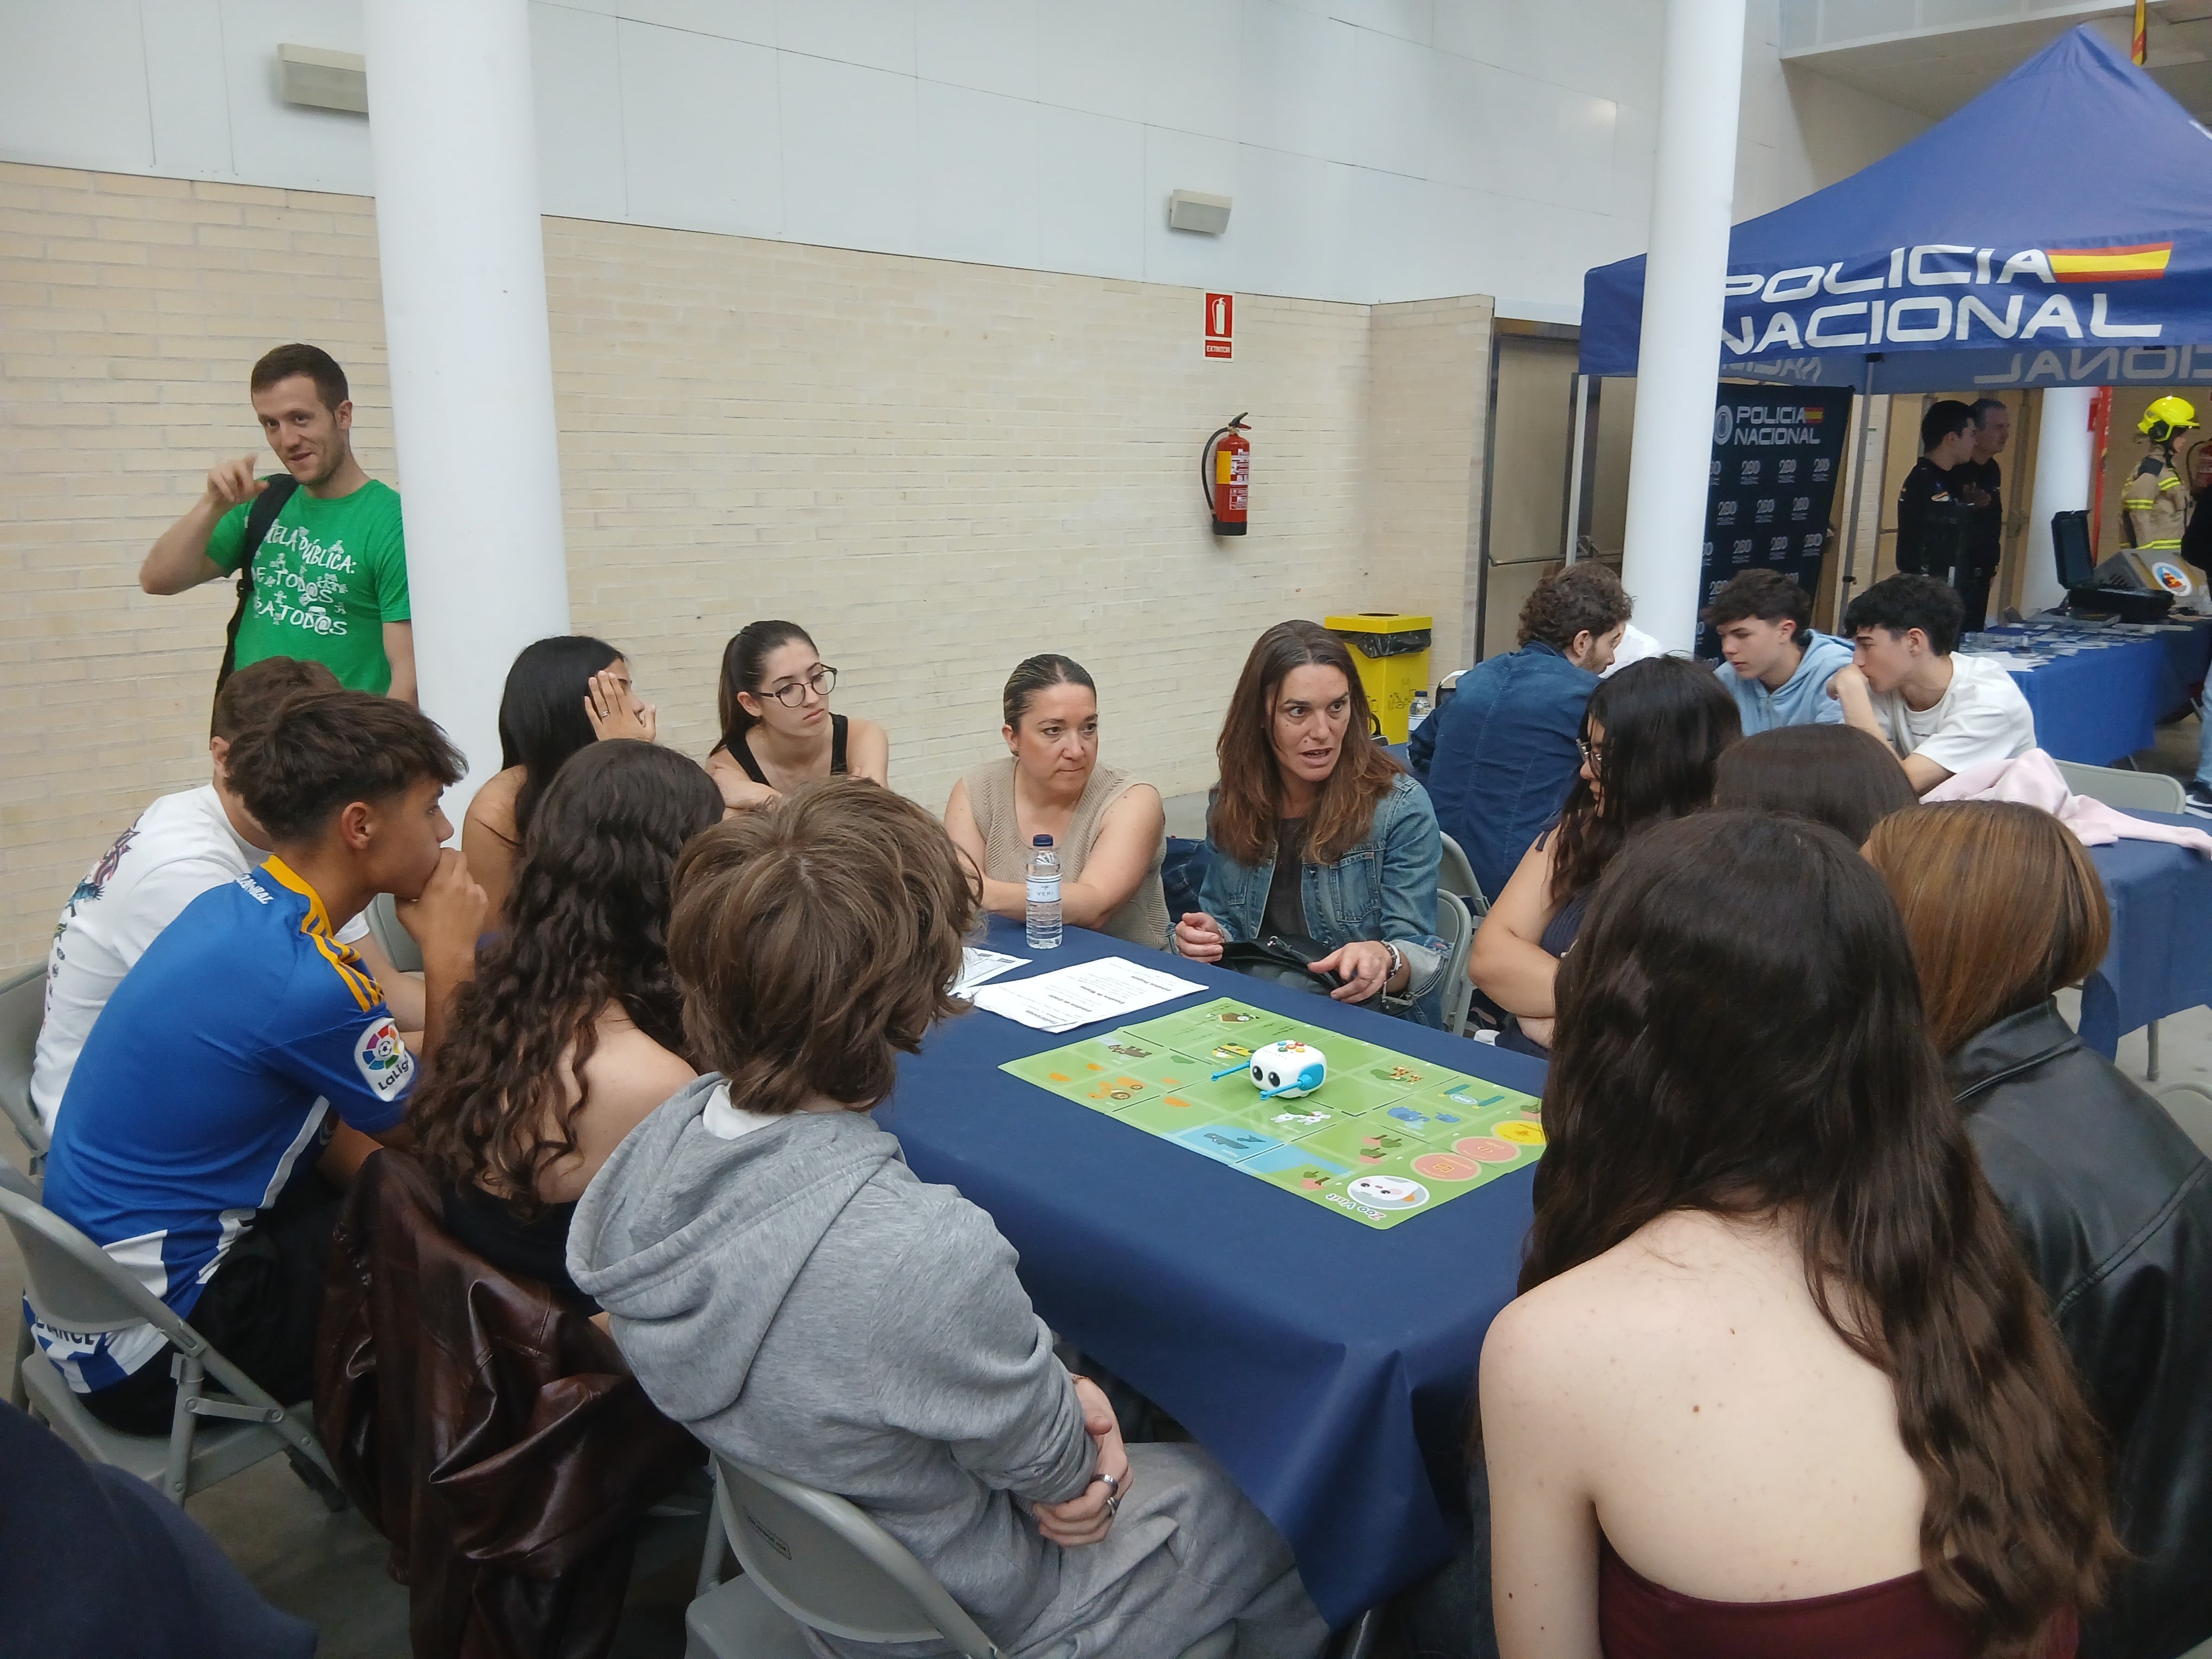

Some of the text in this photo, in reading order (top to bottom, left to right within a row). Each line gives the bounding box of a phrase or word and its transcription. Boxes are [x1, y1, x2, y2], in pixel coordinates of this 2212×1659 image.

[1734, 427, 1821, 445] NACIONAL
[378, 1055, 409, 1091] LaLig
[1358, 1206, 1386, 1221] Zoo
